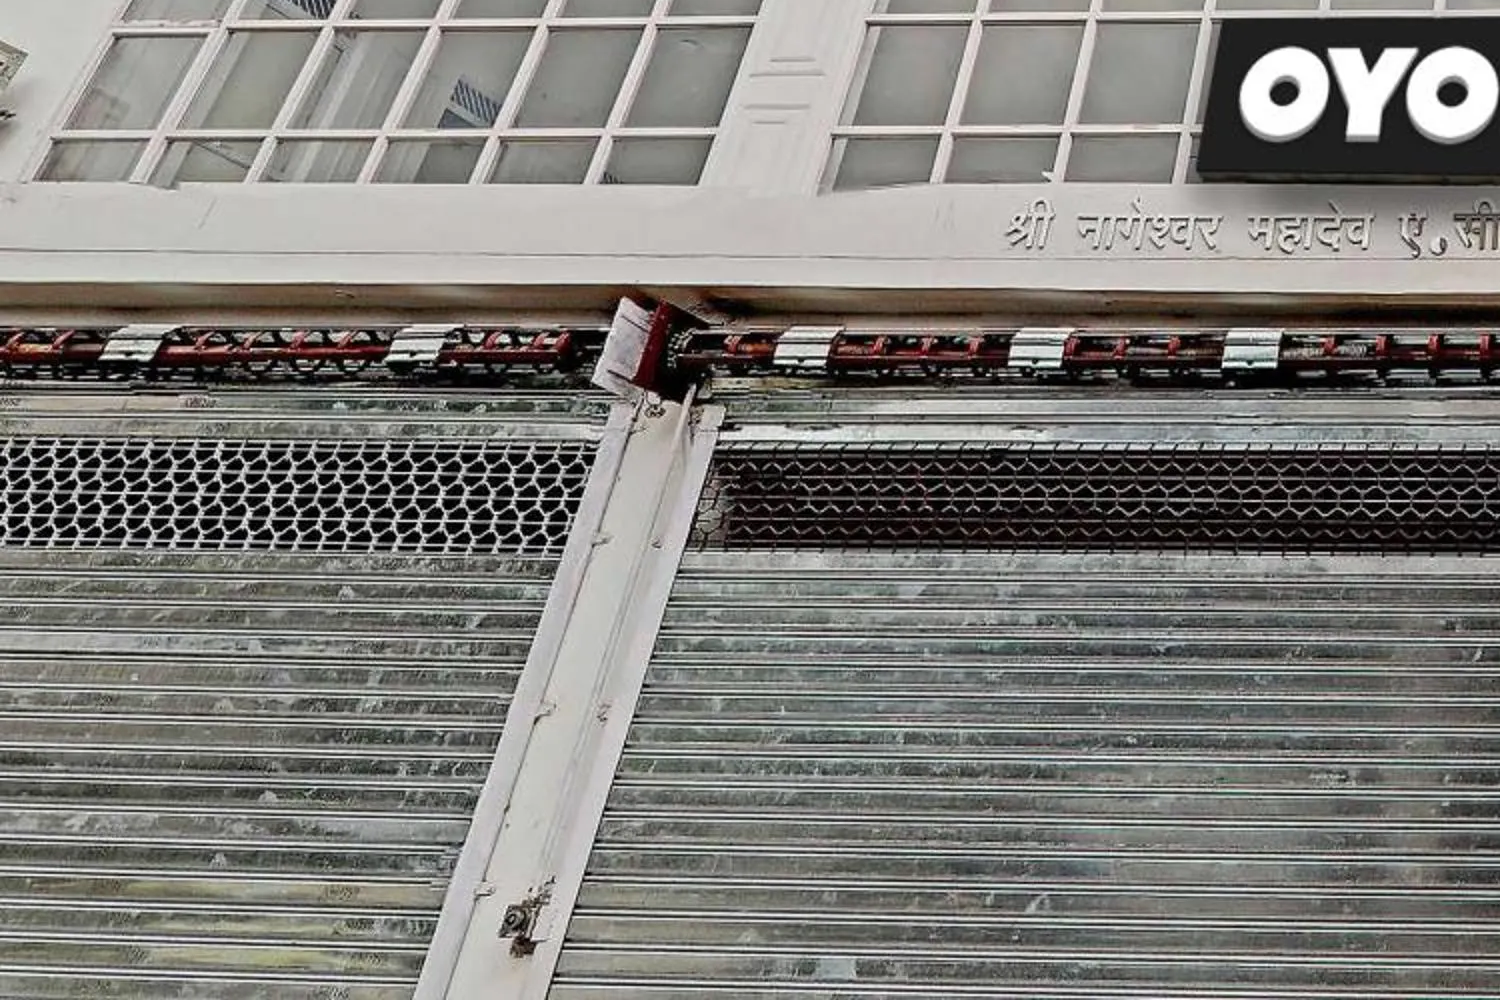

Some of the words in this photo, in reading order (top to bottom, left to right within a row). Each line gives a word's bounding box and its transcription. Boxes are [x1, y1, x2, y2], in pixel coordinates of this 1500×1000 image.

[1239, 46, 1500, 145] OYO
[1004, 199, 1056, 250] श्री
[1077, 197, 1224, 250] नागेश्वर
[1247, 199, 1377, 254] महादेव
